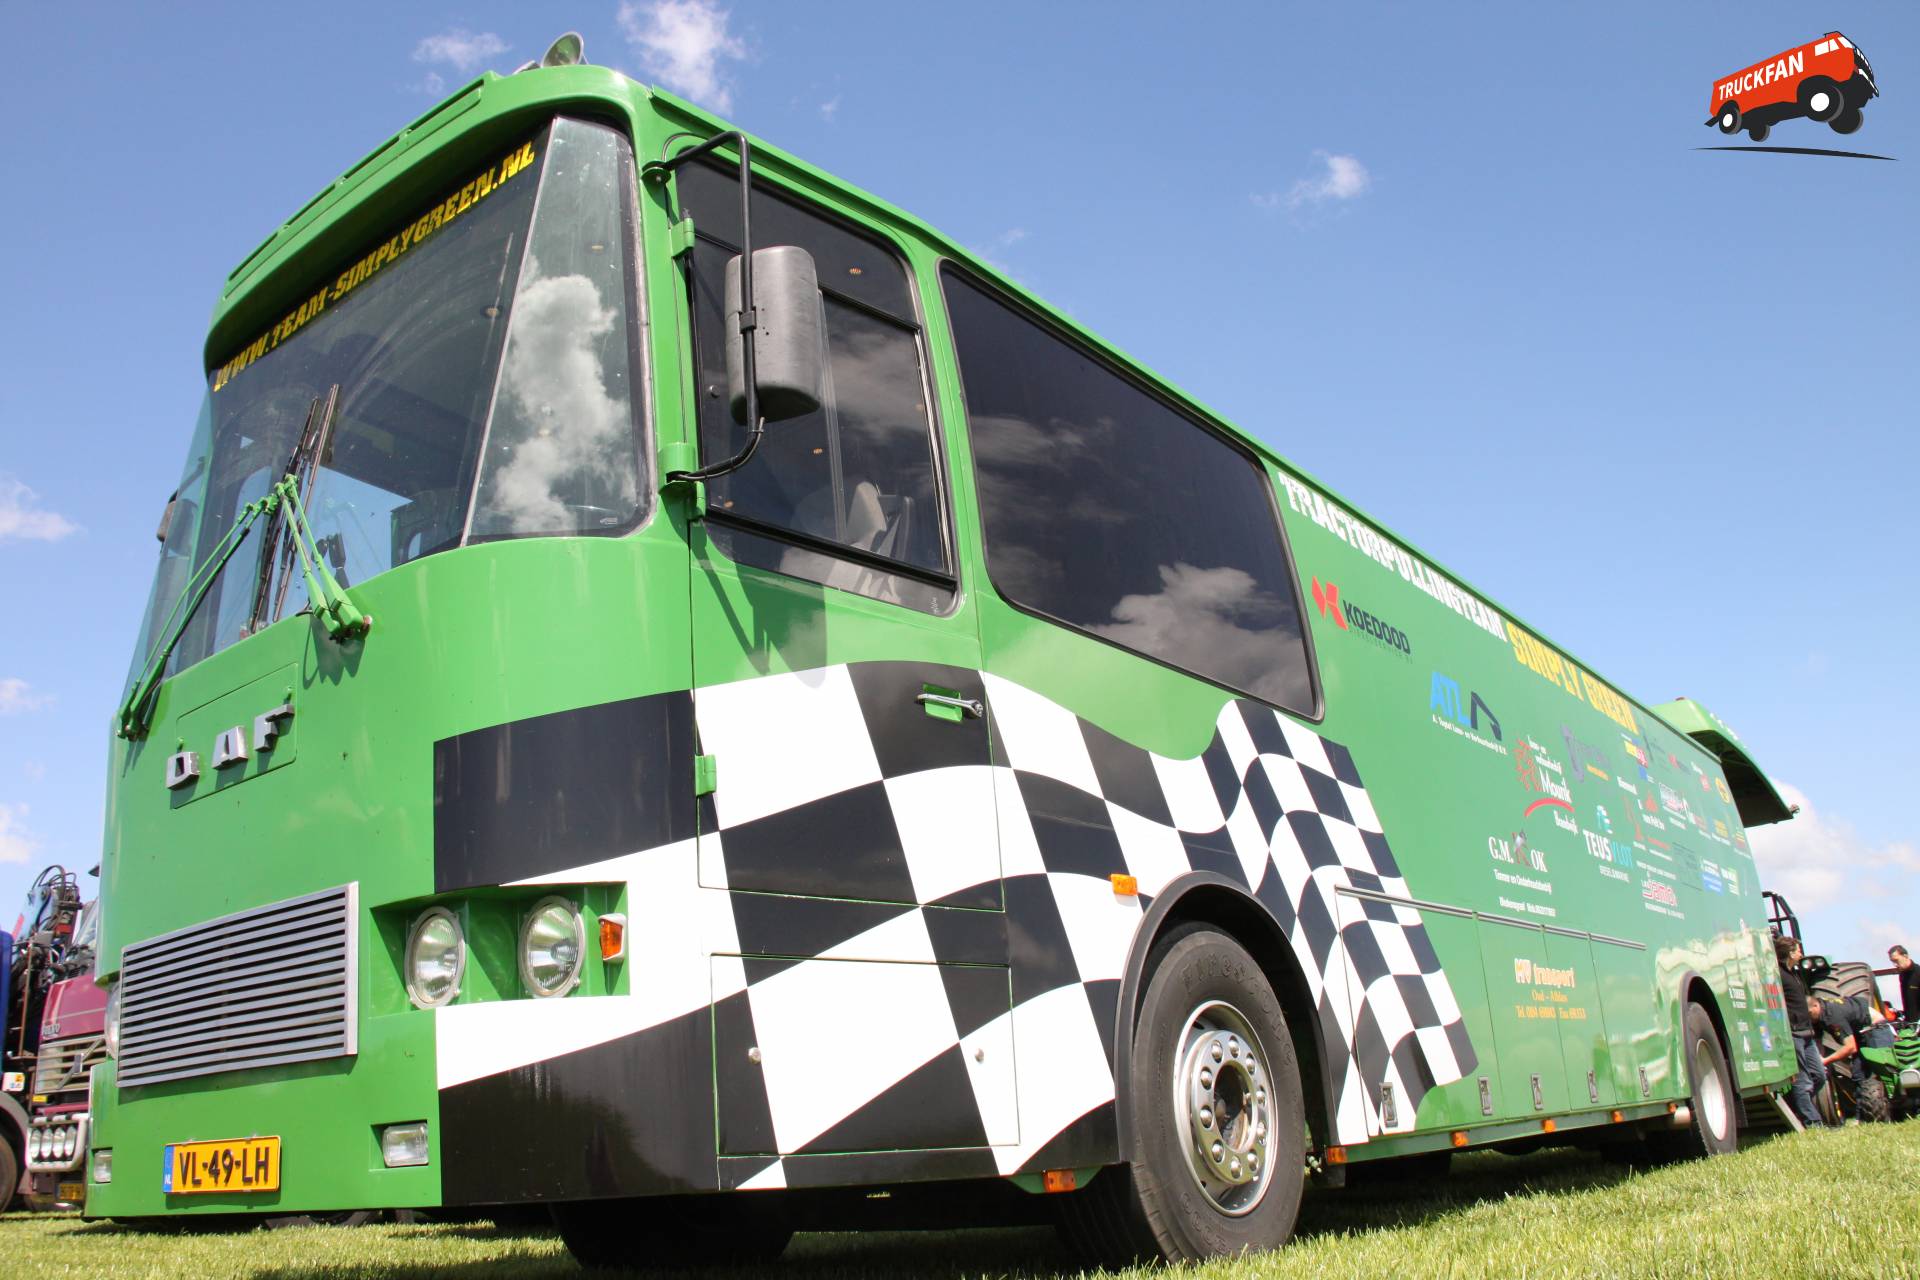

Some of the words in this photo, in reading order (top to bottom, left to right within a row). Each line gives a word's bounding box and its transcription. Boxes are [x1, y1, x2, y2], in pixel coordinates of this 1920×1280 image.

[1342, 599, 1411, 655] KOEDOOD
[166, 704, 295, 790] DAF
[1488, 836, 1515, 864] G.M.
[1582, 829, 1613, 862] TEUS
[164, 1174, 172, 1185] NL
[179, 1146, 270, 1188] VL-49-LH
